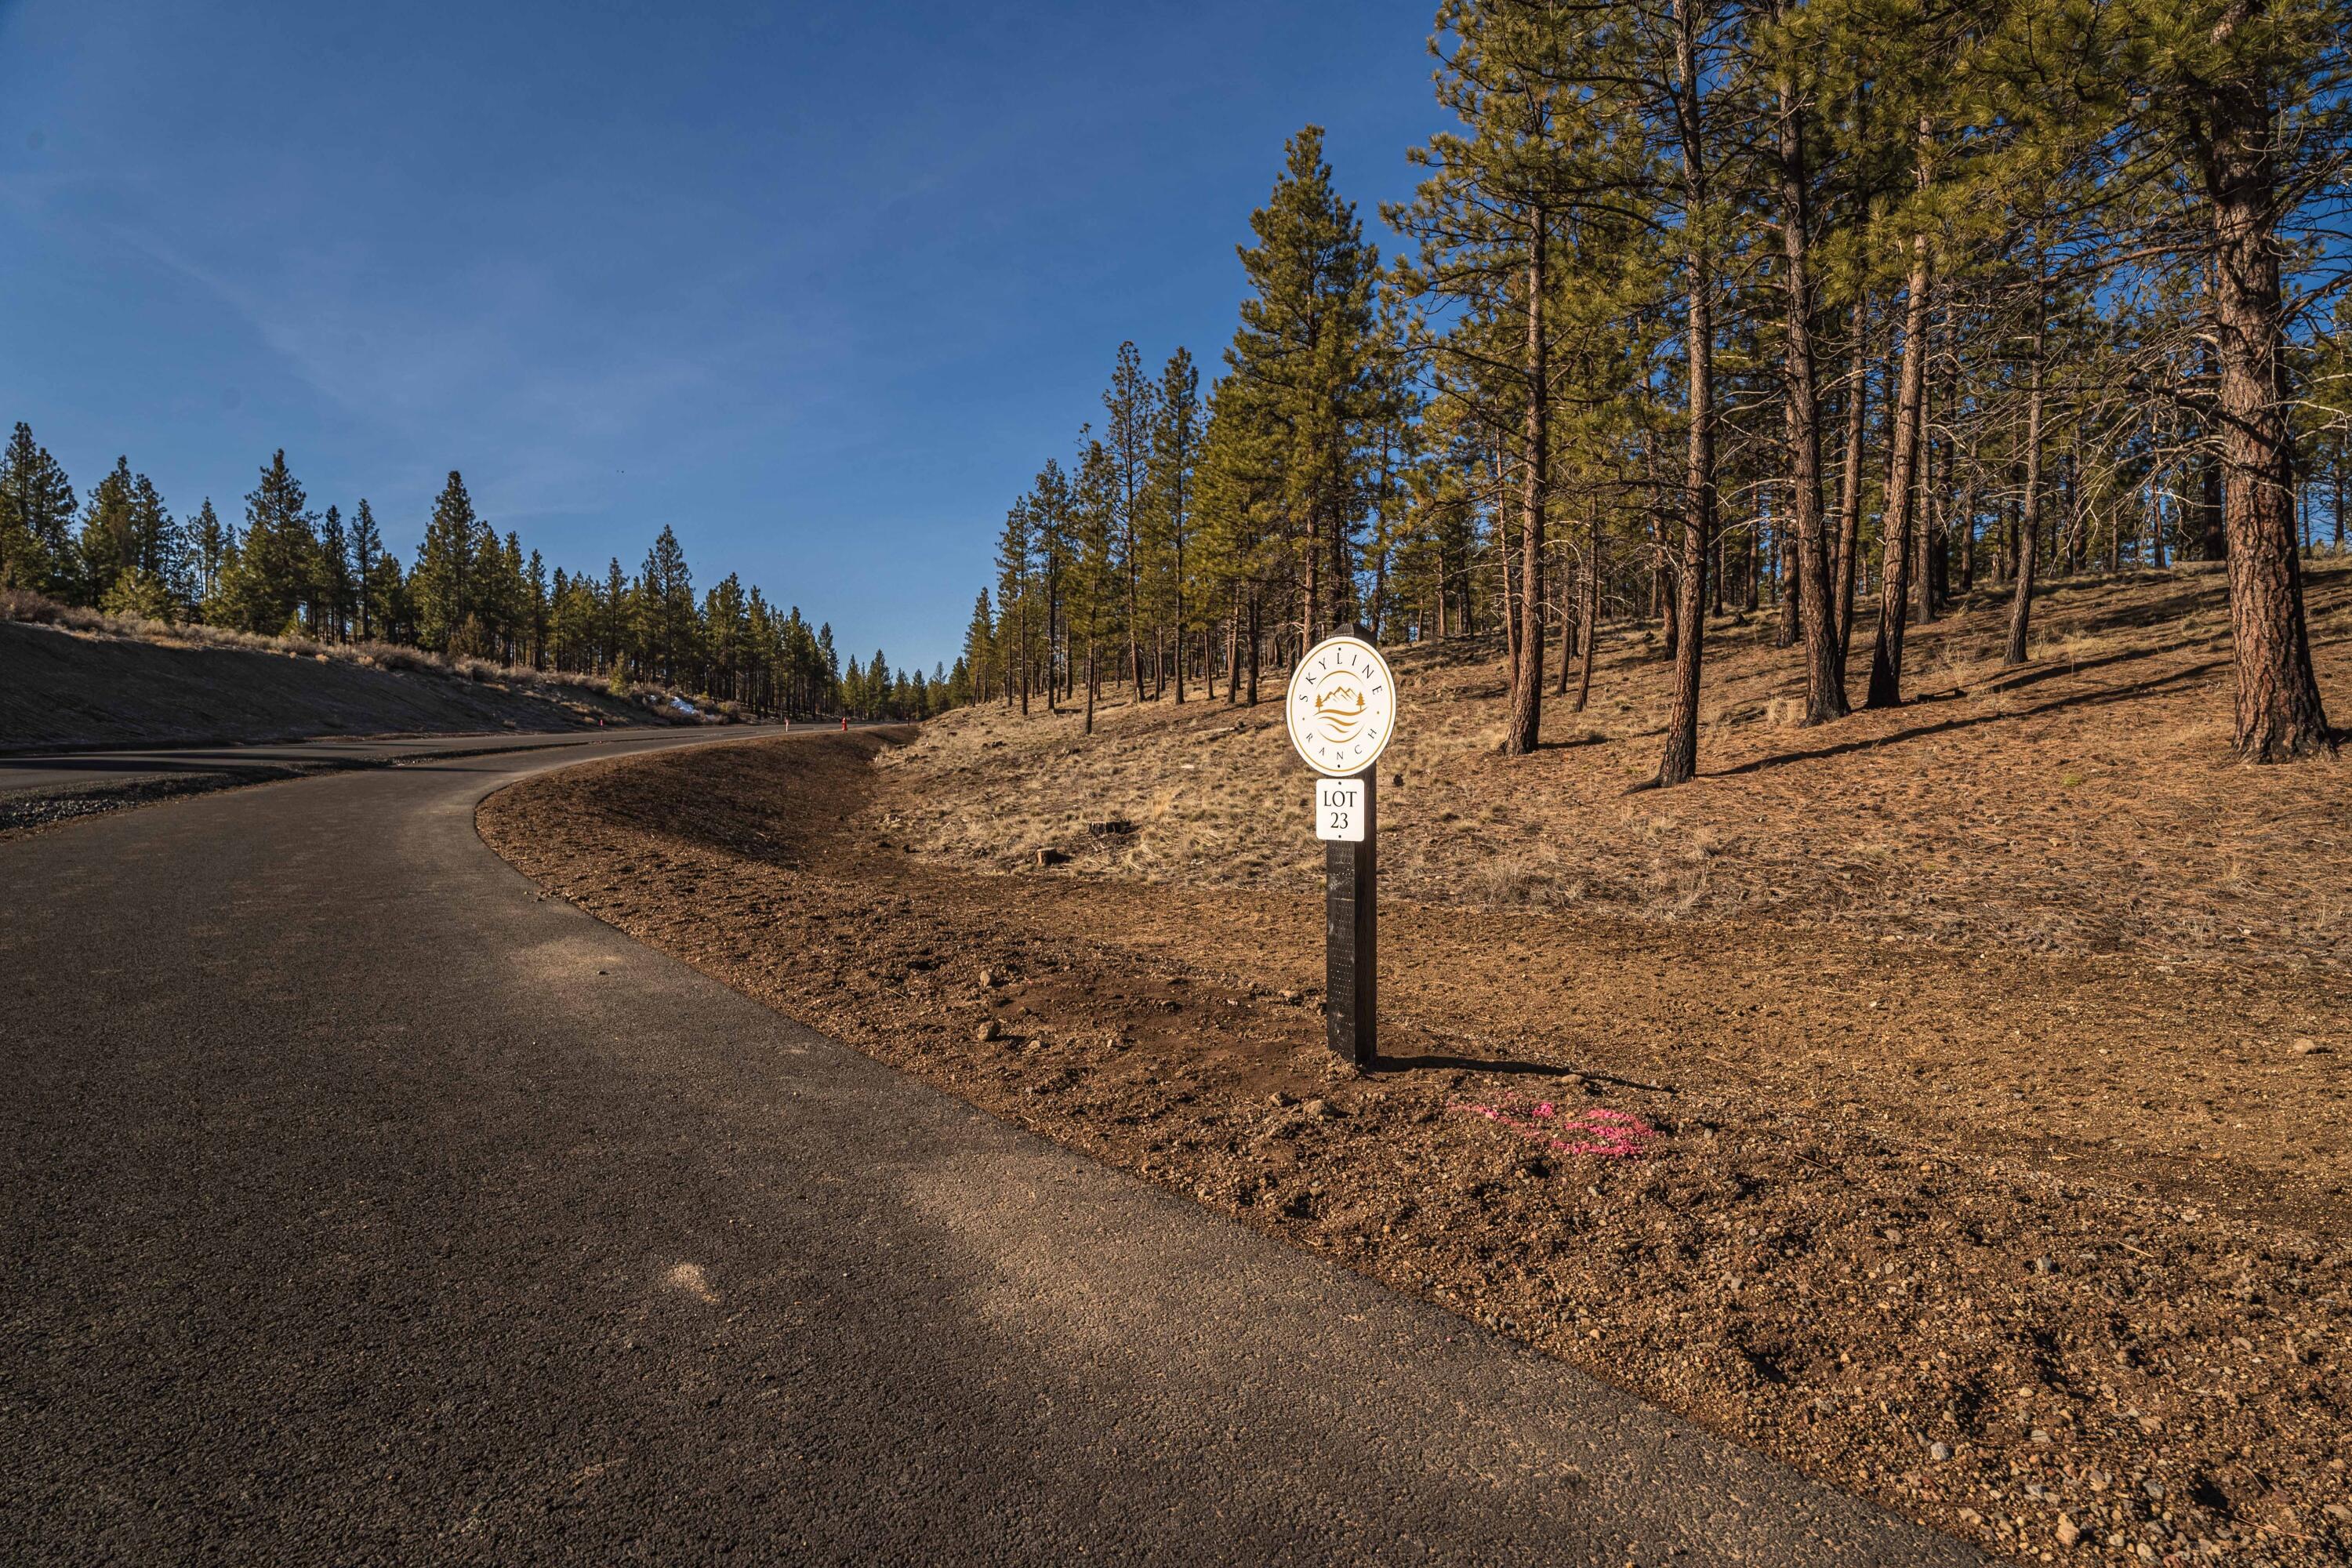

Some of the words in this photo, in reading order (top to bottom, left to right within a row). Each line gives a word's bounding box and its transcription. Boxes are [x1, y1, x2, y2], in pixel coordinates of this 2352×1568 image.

[1299, 652, 1382, 702] SKYLINE
[1306, 728, 1377, 760] RANCH
[1323, 790, 1357, 808] LOT
[1330, 812, 1348, 829] 23
